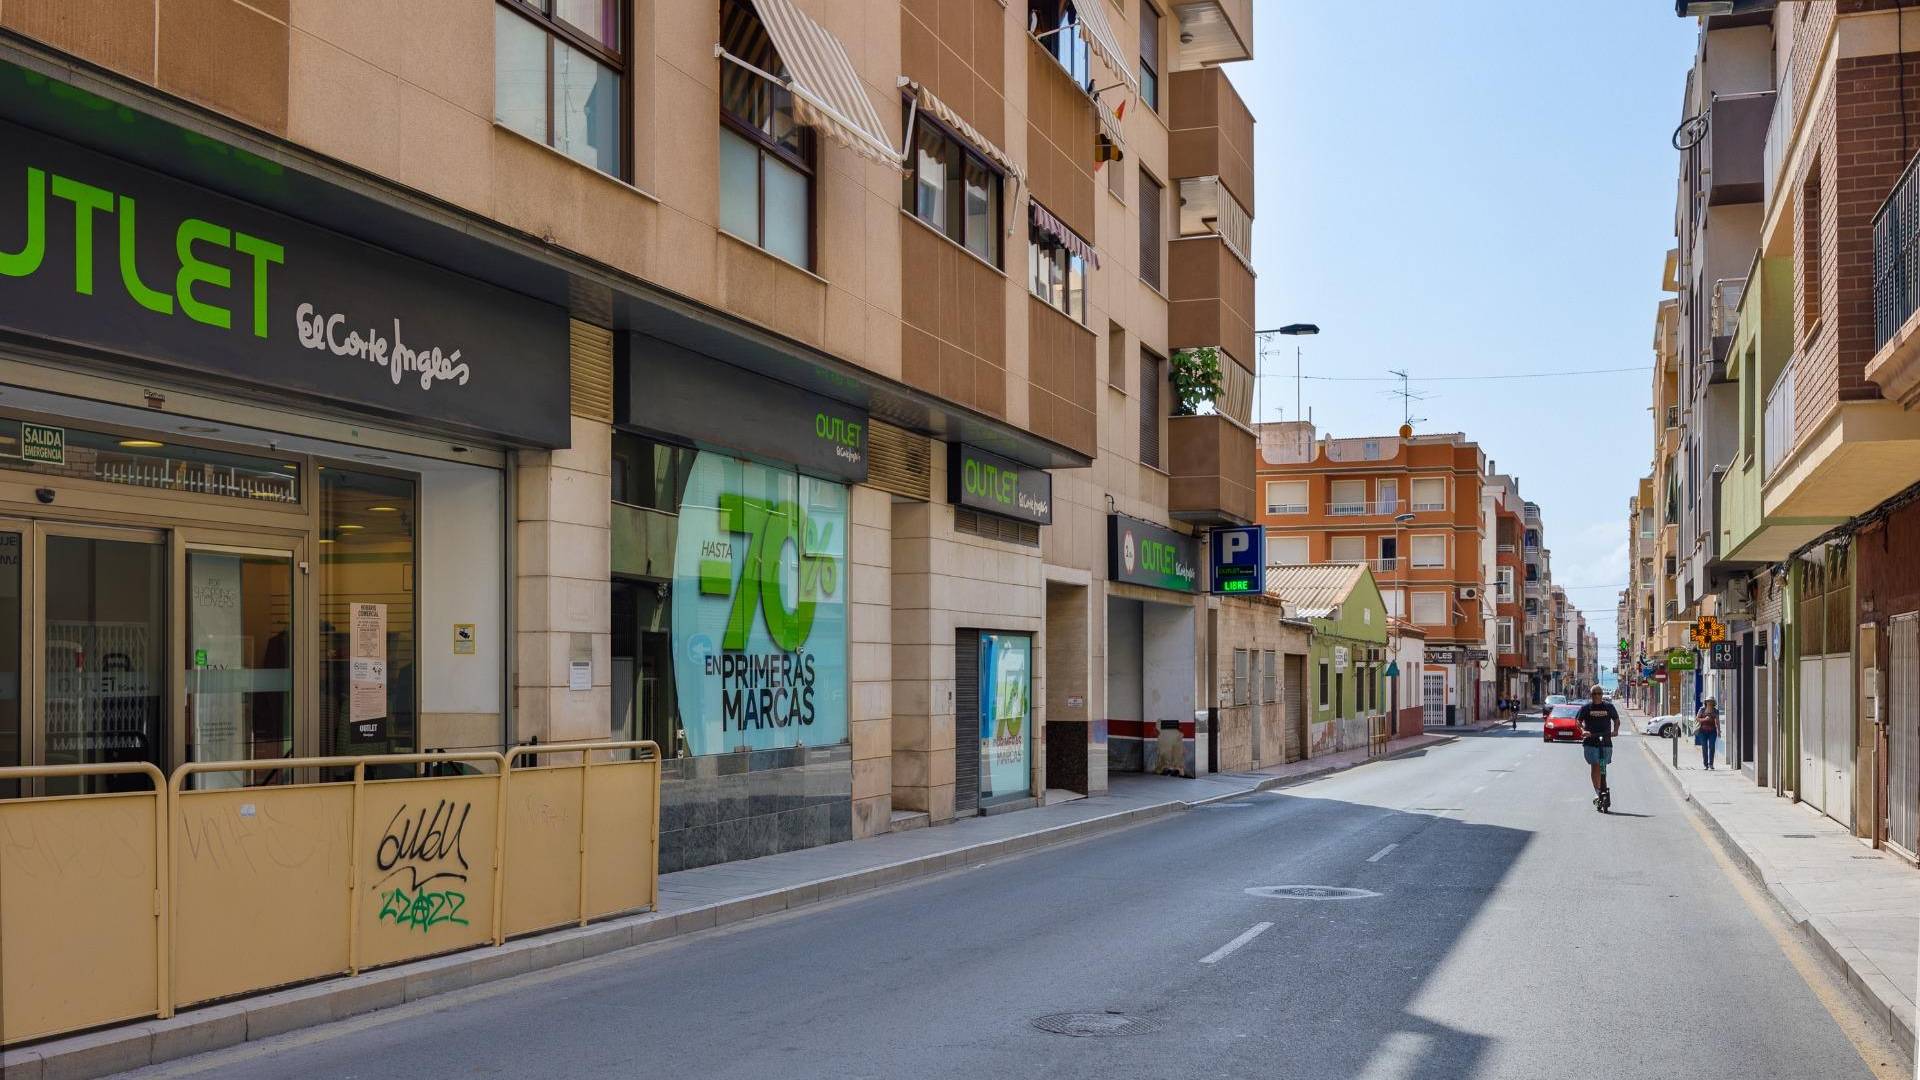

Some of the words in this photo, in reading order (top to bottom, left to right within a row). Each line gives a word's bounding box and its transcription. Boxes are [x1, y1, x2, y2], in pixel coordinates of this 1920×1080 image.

[296, 303, 325, 350] El
[327, 313, 388, 366] Corte
[391, 318, 469, 390] Inglés
[24, 427, 62, 447] SALIDA
[816, 413, 861, 448] OUTLET
[24, 444, 62, 460] EMERGENCIA
[965, 457, 1018, 506] OUTLET
[701, 539, 734, 559] HASTA
[1141, 539, 1176, 576] OUTLET
[1222, 531, 1249, 564] P
[1224, 581, 1248, 590] LIBRE
[705, 654, 722, 676] EN
[722, 654, 816, 689] PRIMERAS
[1670, 656, 1692, 665] CRC
[722, 686, 816, 732] MARCAS
[359, 723, 378, 733] OUTLET
